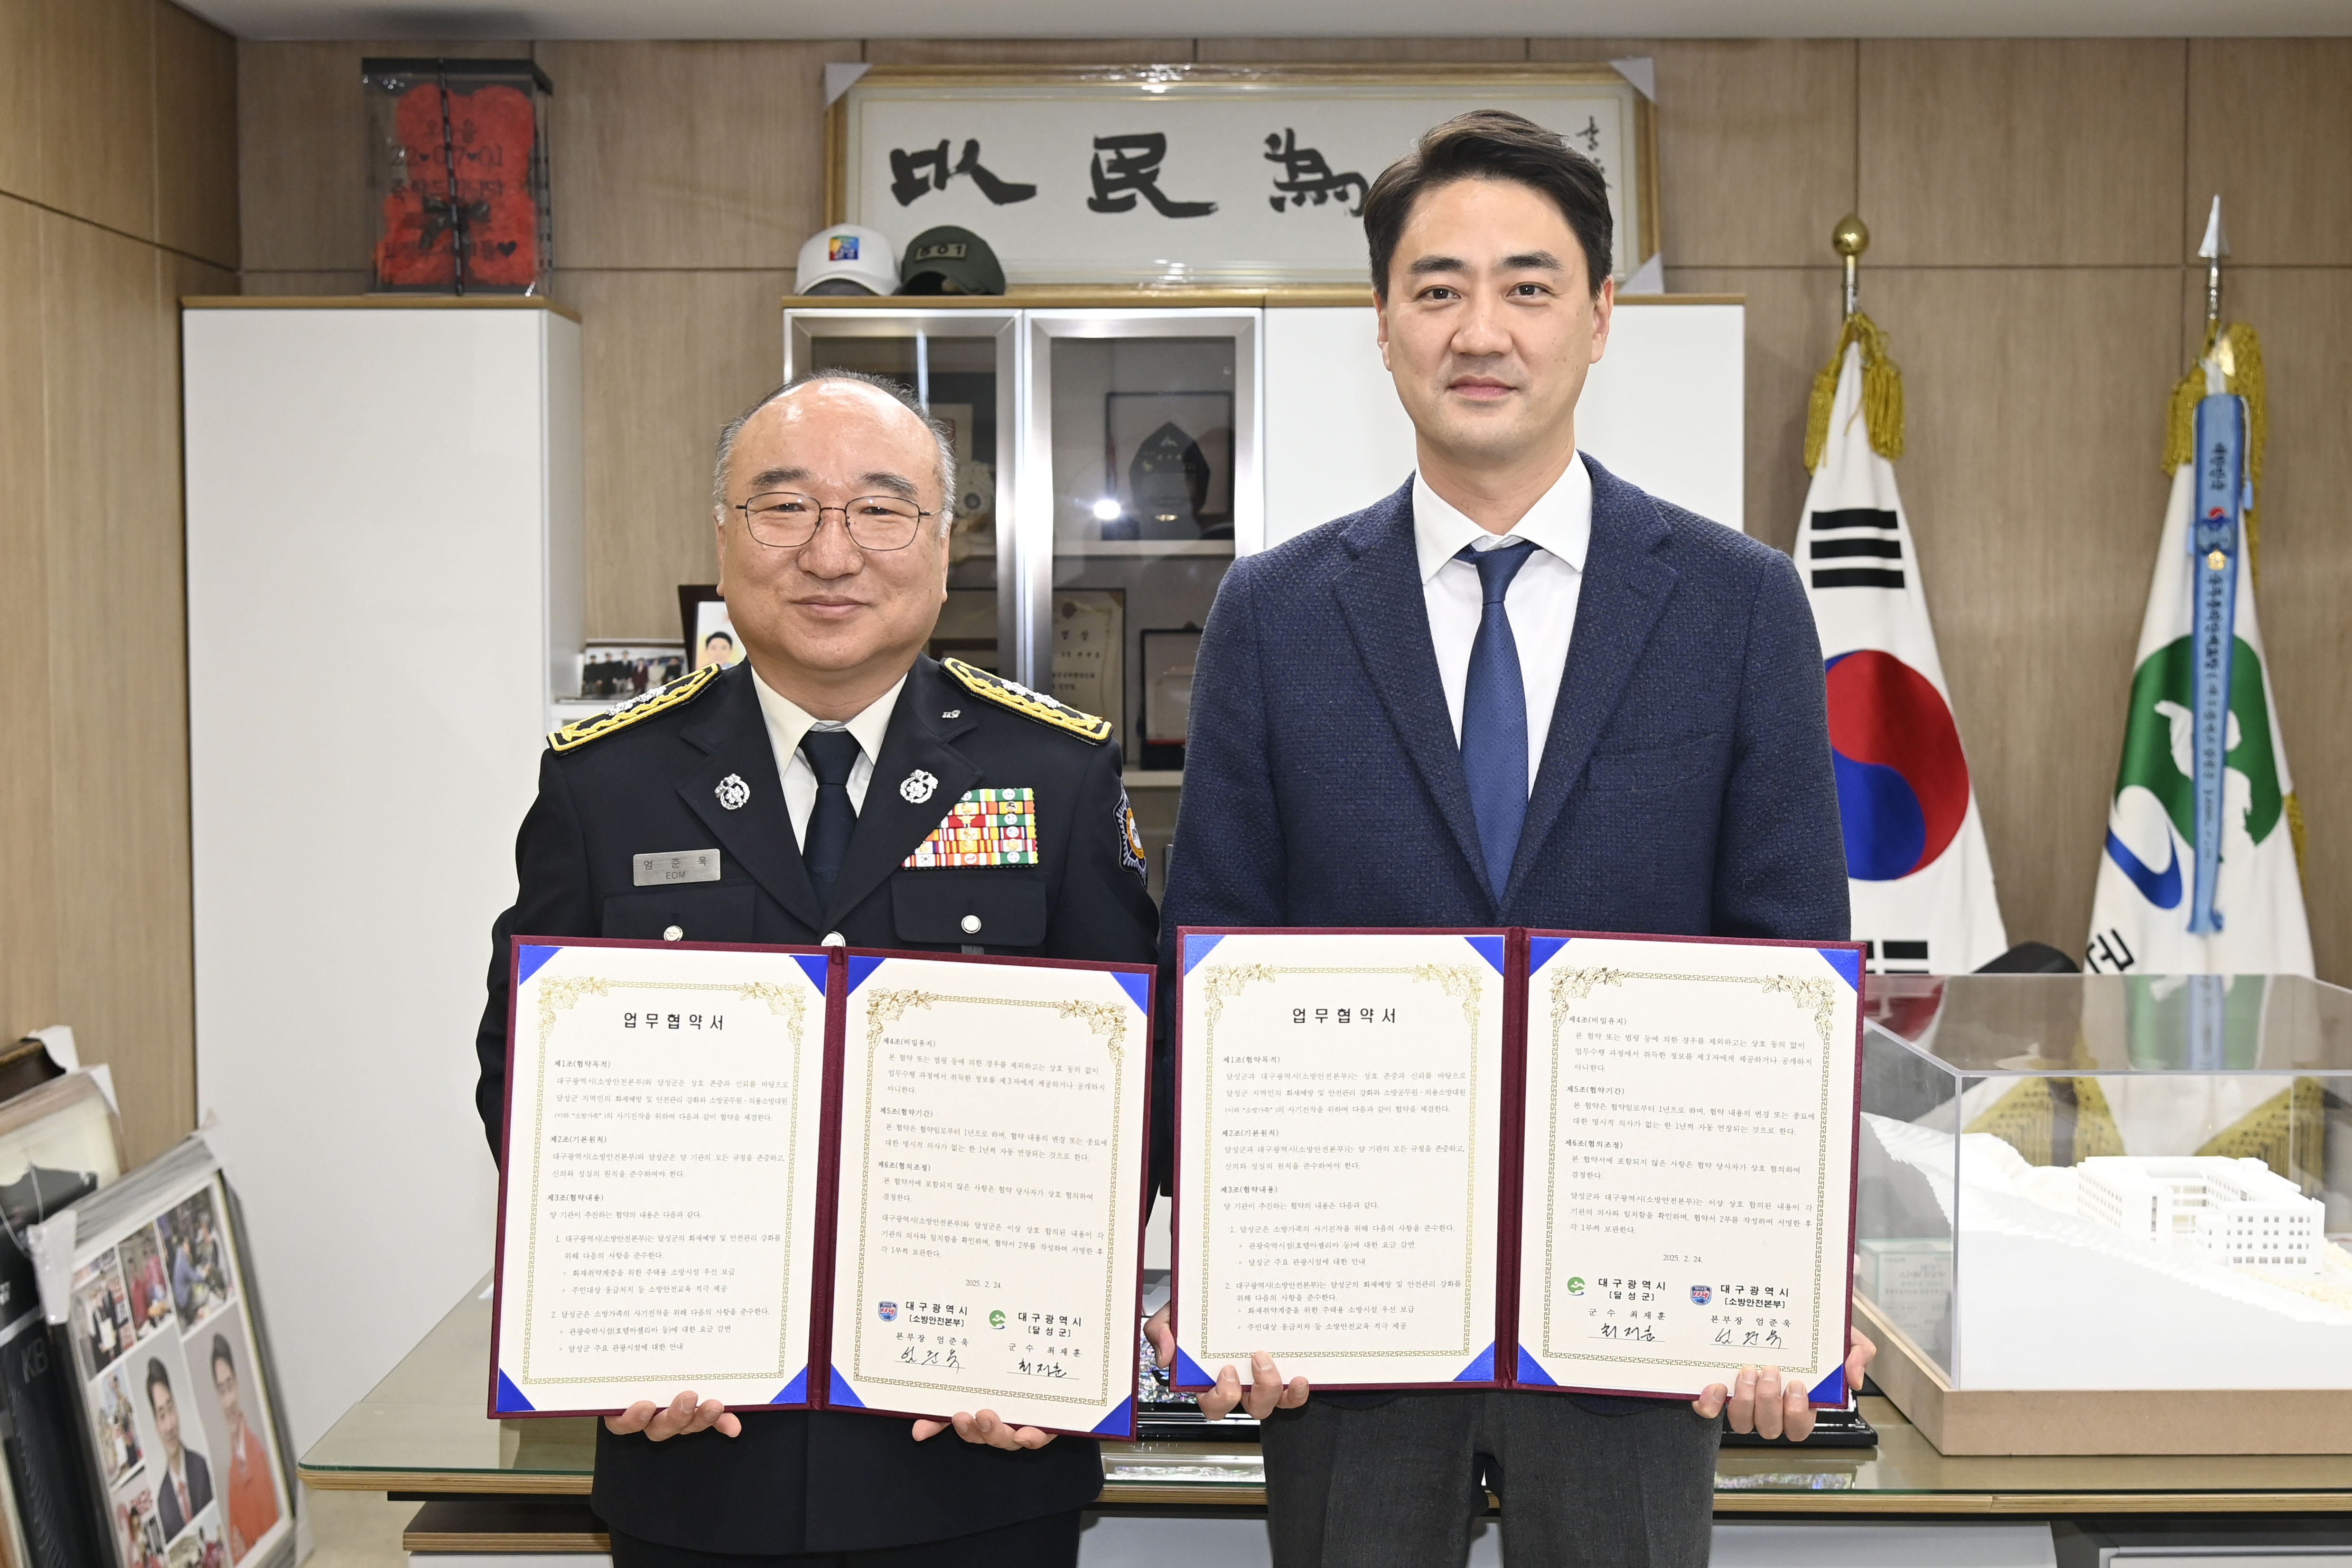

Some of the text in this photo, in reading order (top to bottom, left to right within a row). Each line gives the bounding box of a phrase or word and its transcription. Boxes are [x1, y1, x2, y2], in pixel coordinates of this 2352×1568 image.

[942, 709, 961, 718] 119
[665, 871, 685, 879] EOM
[1292, 1008, 1395, 1024] 업무협약서
[1568, 1015, 1627, 1026] 제4조(비밀유지)
[624, 1012, 723, 1031] 업무협약서
[882, 1036, 936, 1048] 제4조(비밀유지)
[554, 1059, 611, 1069] 제1조(협약목적)
[1222, 1055, 1280, 1064] 제1조(협약목적)
[1574, 1063, 1606, 1073] 아니한다.
[1226, 1071, 1467, 1081] 달성군과 대구광역시(소방안전본부)는 상호 존중과 신뢰를 바탕으로
[557, 1076, 789, 1089] 대구광역시(소방안전본부)와 달성군은 상호 존중과 신뢰를 바탕으로
[887, 1084, 917, 1094] 아니한다.
[1566, 1085, 1625, 1095] 제5조(협약기간)
[879, 1106, 933, 1118] 제5조(협약기간)
[1221, 1129, 1279, 1138] 제2조(기본원칙)
[550, 1135, 607, 1144] 제2조(기본원칙)
[1564, 1139, 1623, 1149] 제6조(협의조정)
[877, 1160, 931, 1172] 제6조(협의조정)
[1571, 1170, 1603, 1180] 결정한다.
[1220, 1185, 1278, 1194] 제3조(협약내용)
[547, 1193, 604, 1202] 제3조(협약내용)
[882, 1192, 912, 1203] 결정한다.
[1570, 1191, 1813, 1213] 달성군과 대구광역시(소방안전본부)는 이상 상호 합의된 내용이 각
[882, 1213, 1105, 1241] 대구광역시(소방안전본부)와 달성군은 이상 상호 합의된 내용이 각
[1569, 1223, 1636, 1234] 각 1부씩 보관한다.
[881, 1229, 1104, 1257] 기관의 의사와 일치함을 확인하며, 협약서 2부를 작성하여 서명한 후
[1342, 1241, 1360, 1250] 등)에
[1363, 1241, 1379, 1250] 대한
[1381, 1241, 1397, 1249] 요금
[1400, 1240, 1415, 1249] 감면
[564, 1251, 664, 1260] 위해 다음의 사항을 준수한다.
[880, 1245, 942, 1259] 각 1부씩 보관한다.
[1248, 1257, 1366, 1267] 달성군 주요 관광시설에 대한 안내
[1662, 1254, 1680, 1262] 2025.
[1693, 1255, 1703, 1263] 24.
[572, 1268, 736, 1278] 화재취약계층을 위한 주택용 소방시설 우선 보급
[965, 1279, 982, 1287] 2025.
[571, 1284, 728, 1295] 주민대상 응급처치 등 소방안전교육 적극 제공
[1236, 1293, 1338, 1303] 위해 다음의 사항을 준수한다.
[1247, 1305, 1415, 1315] 화재취약계층을 위한 주택용 소방시설 우선 보급
[661, 1325, 678, 1335] 등)에
[681, 1325, 696, 1334] 대한
[699, 1325, 714, 1334] 요금
[717, 1324, 731, 1333] 감면
[1247, 1322, 1408, 1332] 주민대상 응급처치 등 소방안전교육 적극 제공
[568, 1342, 683, 1353] 달성군 주요 관광시설에 대한 안내
